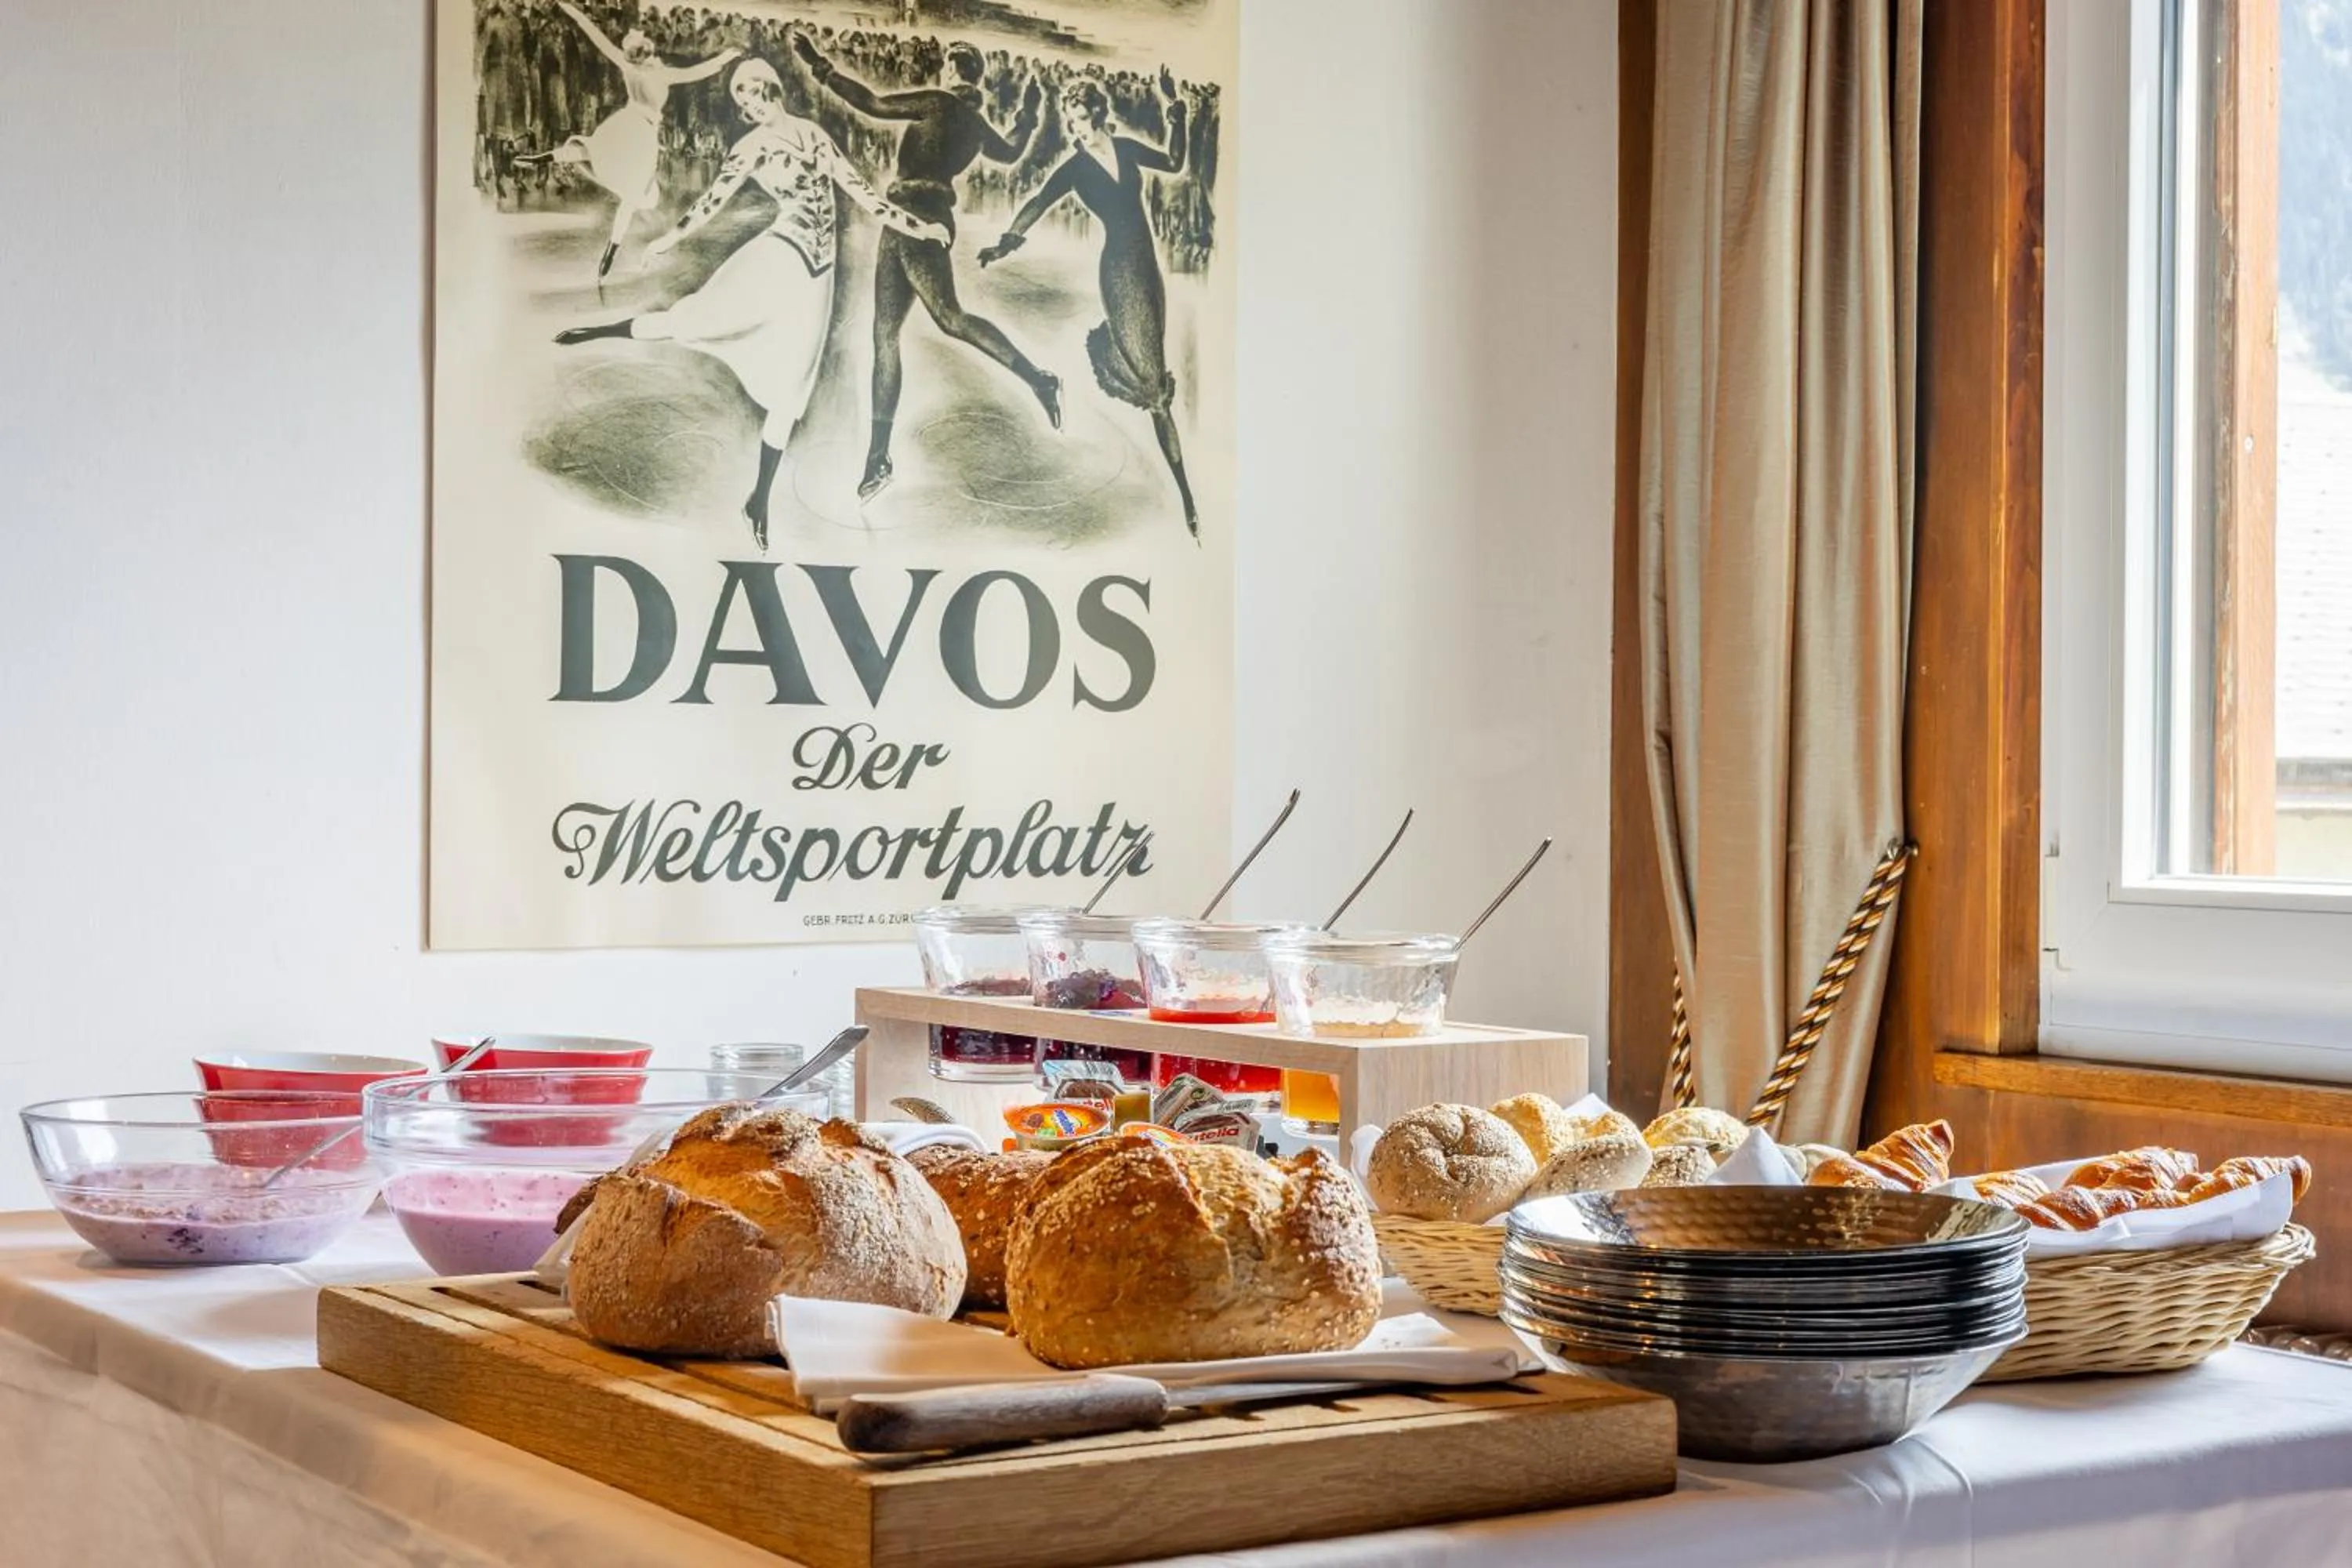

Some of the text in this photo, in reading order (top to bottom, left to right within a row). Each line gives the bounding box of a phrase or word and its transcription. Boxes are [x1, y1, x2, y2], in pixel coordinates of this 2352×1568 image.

[548, 554, 1156, 713] DAVOS
[792, 722, 950, 791] Der
[551, 799, 1155, 902] Weltsportplatz
